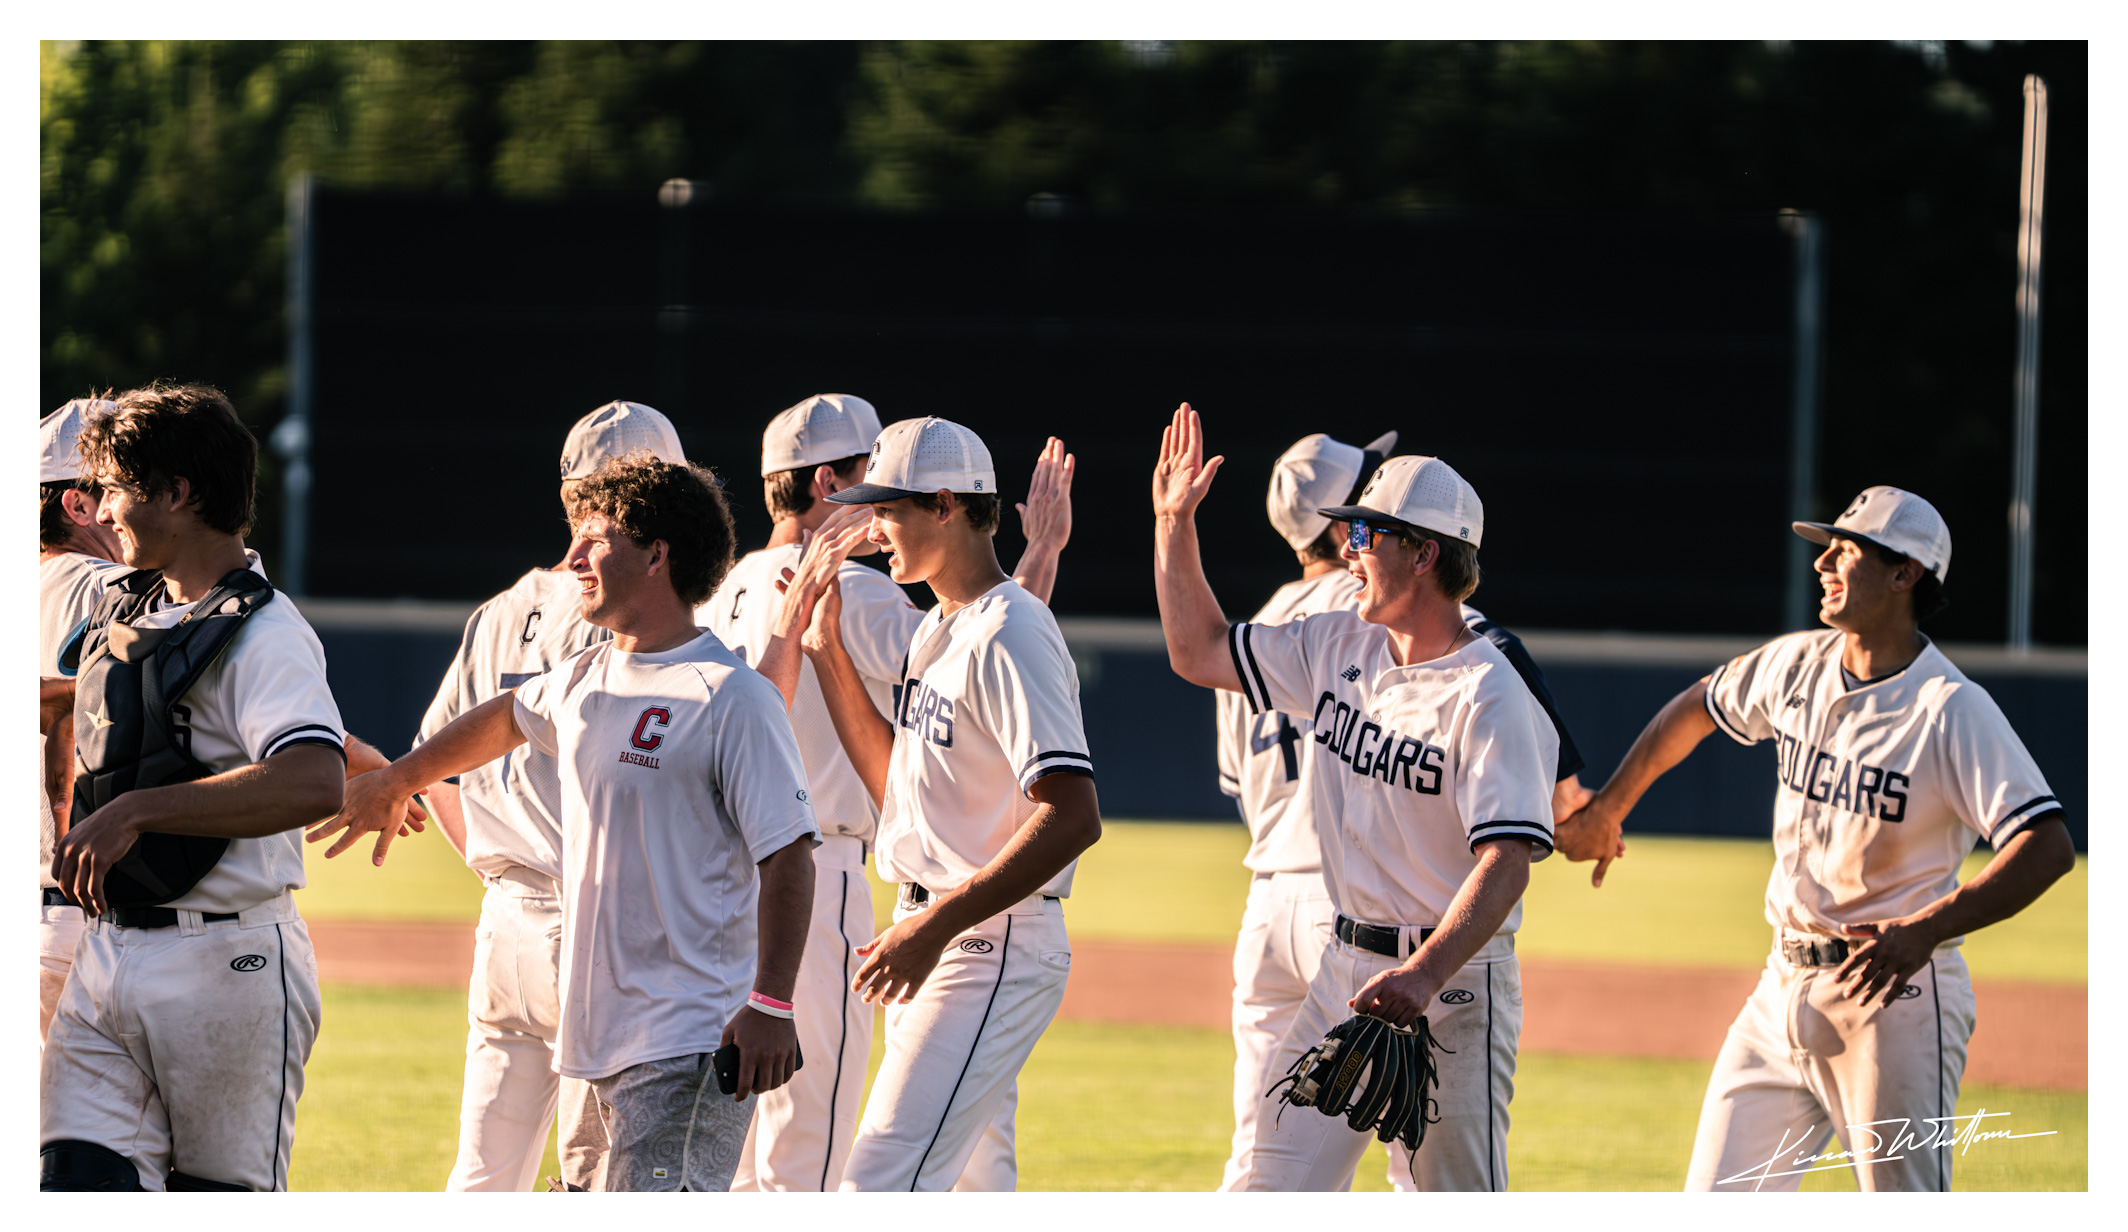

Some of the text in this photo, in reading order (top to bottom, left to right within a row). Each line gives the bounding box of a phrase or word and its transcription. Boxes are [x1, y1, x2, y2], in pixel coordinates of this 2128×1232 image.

[866, 440, 881, 473] C
[1362, 468, 1384, 497] C
[1844, 493, 1868, 519] C
[730, 587, 747, 622] C
[520, 608, 542, 646] C
[629, 705, 673, 753] C
[619, 751, 660, 769] BASEBALL
[1335, 1050, 1363, 1095] A2000
